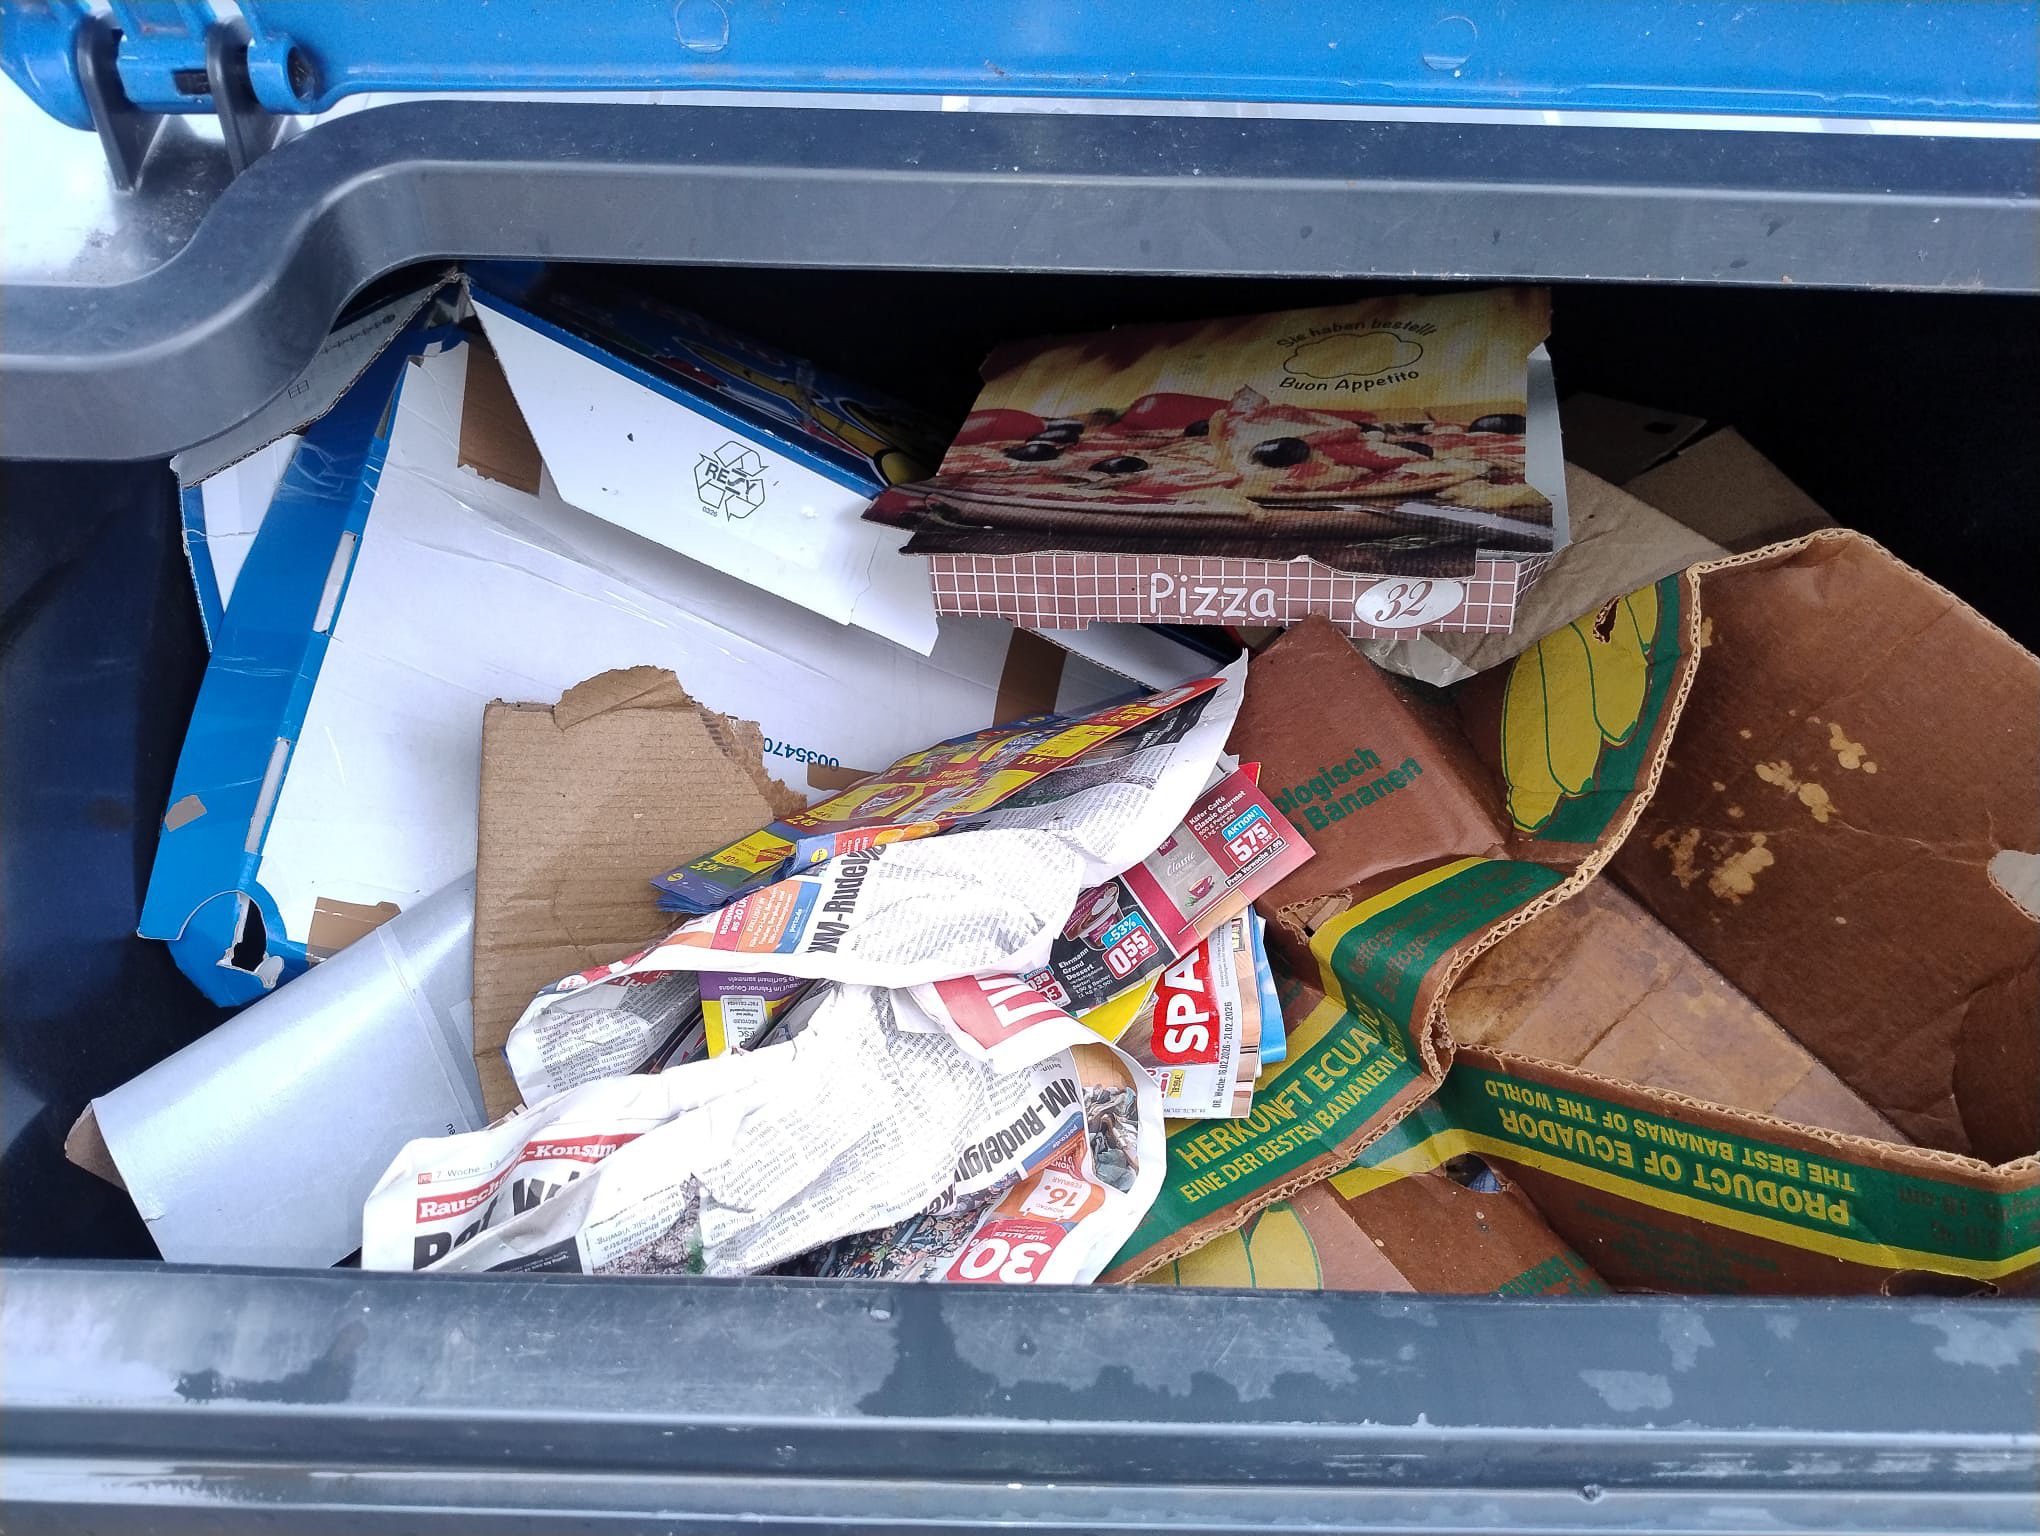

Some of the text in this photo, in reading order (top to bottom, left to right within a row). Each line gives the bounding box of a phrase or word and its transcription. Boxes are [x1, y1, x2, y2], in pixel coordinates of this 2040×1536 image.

[1309, 319, 1365, 338] haben
[1279, 370, 1420, 393] Buon Appetito
[704, 462, 757, 495] RESY
[1150, 572, 1277, 618] Pizza
[1375, 580, 1434, 622] 32
[1273, 748, 1382, 816] ologisch
[1303, 757, 1423, 832] Bananen
[1187, 794, 1226, 825] Käfer Caffé
[1192, 788, 1247, 832] Classic Gourmet
[1225, 809, 1259, 836] AKTION!
[1229, 822, 1269, 863] 5.75
[1267, 839, 1283, 855] 7.99
[732, 907, 744, 921] 20
[1109, 918, 1137, 943] -53%
[1058, 948, 1089, 969] Ehrmann
[1062, 961, 1085, 975] Grand
[1108, 930, 1149, 975] 0.55
[1065, 964, 1095, 981] Dessert
[1164, 948, 1210, 1054] SPA
[1174, 1081, 1313, 1171] HERKUNFT
[1180, 1054, 1397, 1205] EINE DER BESTEN BANANEN
[1486, 1079, 1858, 1192] THE BEST BANANAS OF THE WORLD
[1501, 1106, 1638, 1168] ECUADOR
[447, 1166, 480, 1178] Woche
[1640, 1148, 1684, 1182] OF
[1044, 1185, 1079, 1207] 16.
[1691, 1162, 1853, 1227] PRODUCT
[993, 1231, 1048, 1242] AUF ALLES
